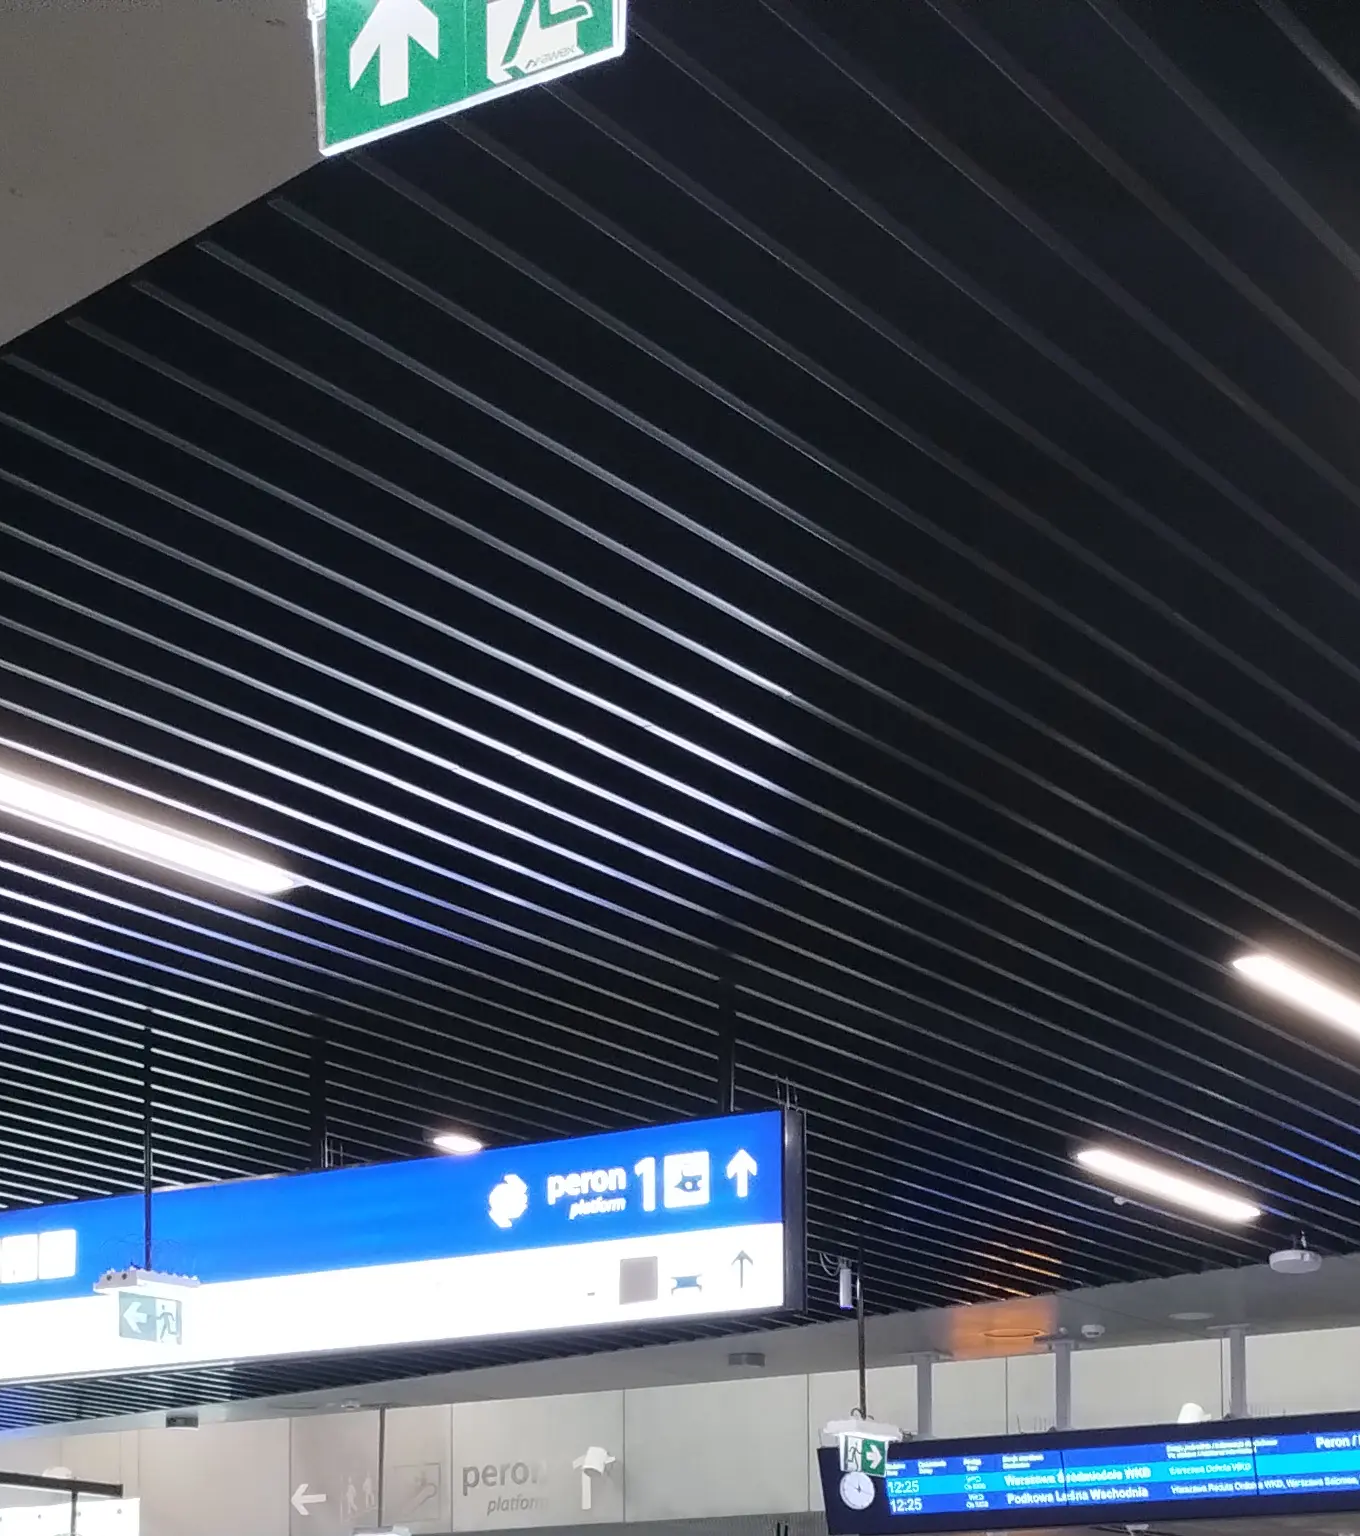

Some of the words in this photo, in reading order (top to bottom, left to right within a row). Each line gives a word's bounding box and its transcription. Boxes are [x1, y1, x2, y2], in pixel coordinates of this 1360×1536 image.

[547, 1167, 627, 1205] peron
[634, 1156, 656, 1212] 1
[568, 1197, 627, 1221] platform
[1315, 1435, 1350, 1449] Peron
[1351, 1434, 1358, 1447] /
[462, 1461, 545, 1496] pero
[887, 1480, 920, 1493] 12:25
[487, 1493, 547, 1517] platfor
[890, 1497, 923, 1513] 12:25
[1006, 1492, 1054, 1504] Podkowa
[1089, 1486, 1149, 1501] Wschodnia
